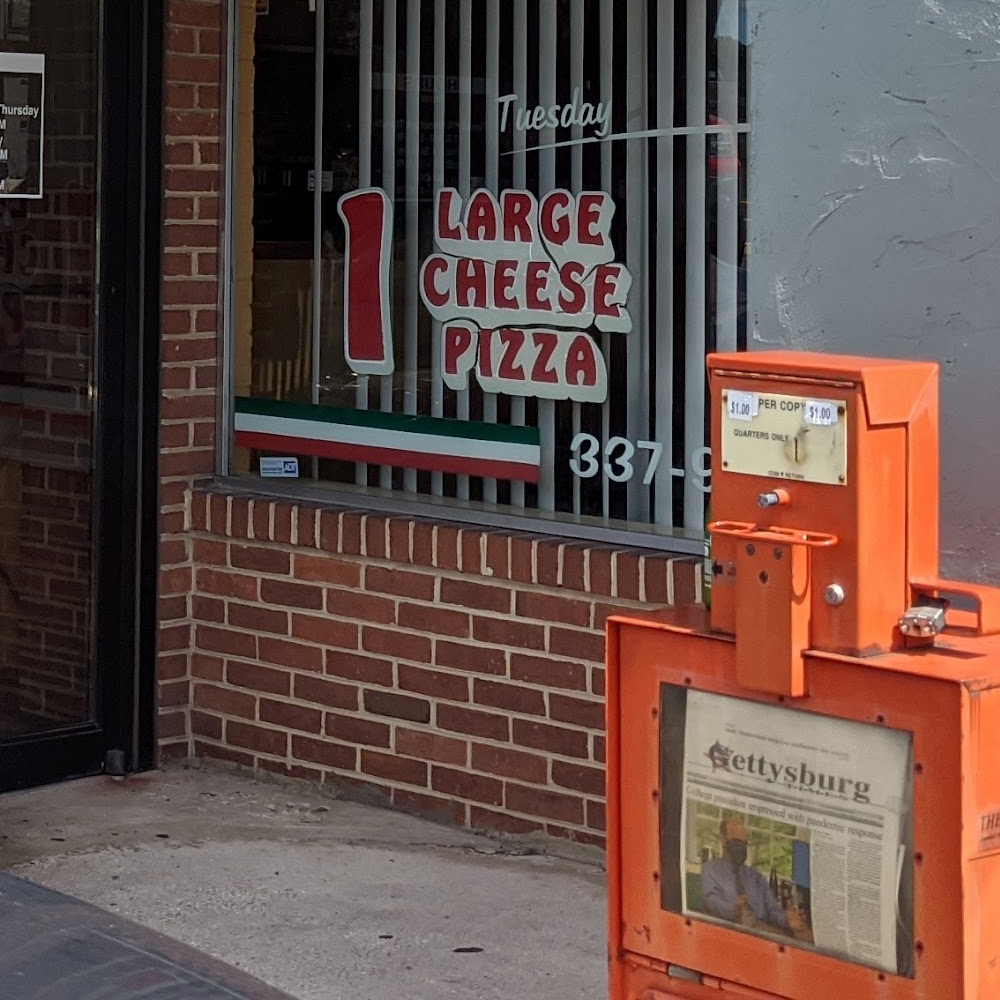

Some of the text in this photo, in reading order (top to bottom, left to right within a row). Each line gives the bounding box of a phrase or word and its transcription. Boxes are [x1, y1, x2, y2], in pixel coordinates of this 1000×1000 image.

[494, 87, 611, 137] Tuesday
[438, 190, 607, 248] LARGE
[340, 190, 389, 368] 1
[422, 256, 623, 318] CHEESE
[444, 326, 598, 387] PIZZA
[730, 401, 750, 416] $1.00
[759, 398, 806, 412] PER COPY
[809, 405, 831, 420] $1.00
[733, 428, 788, 442] QUARTERS ONLY
[704, 738, 871, 804] Gettysburg
